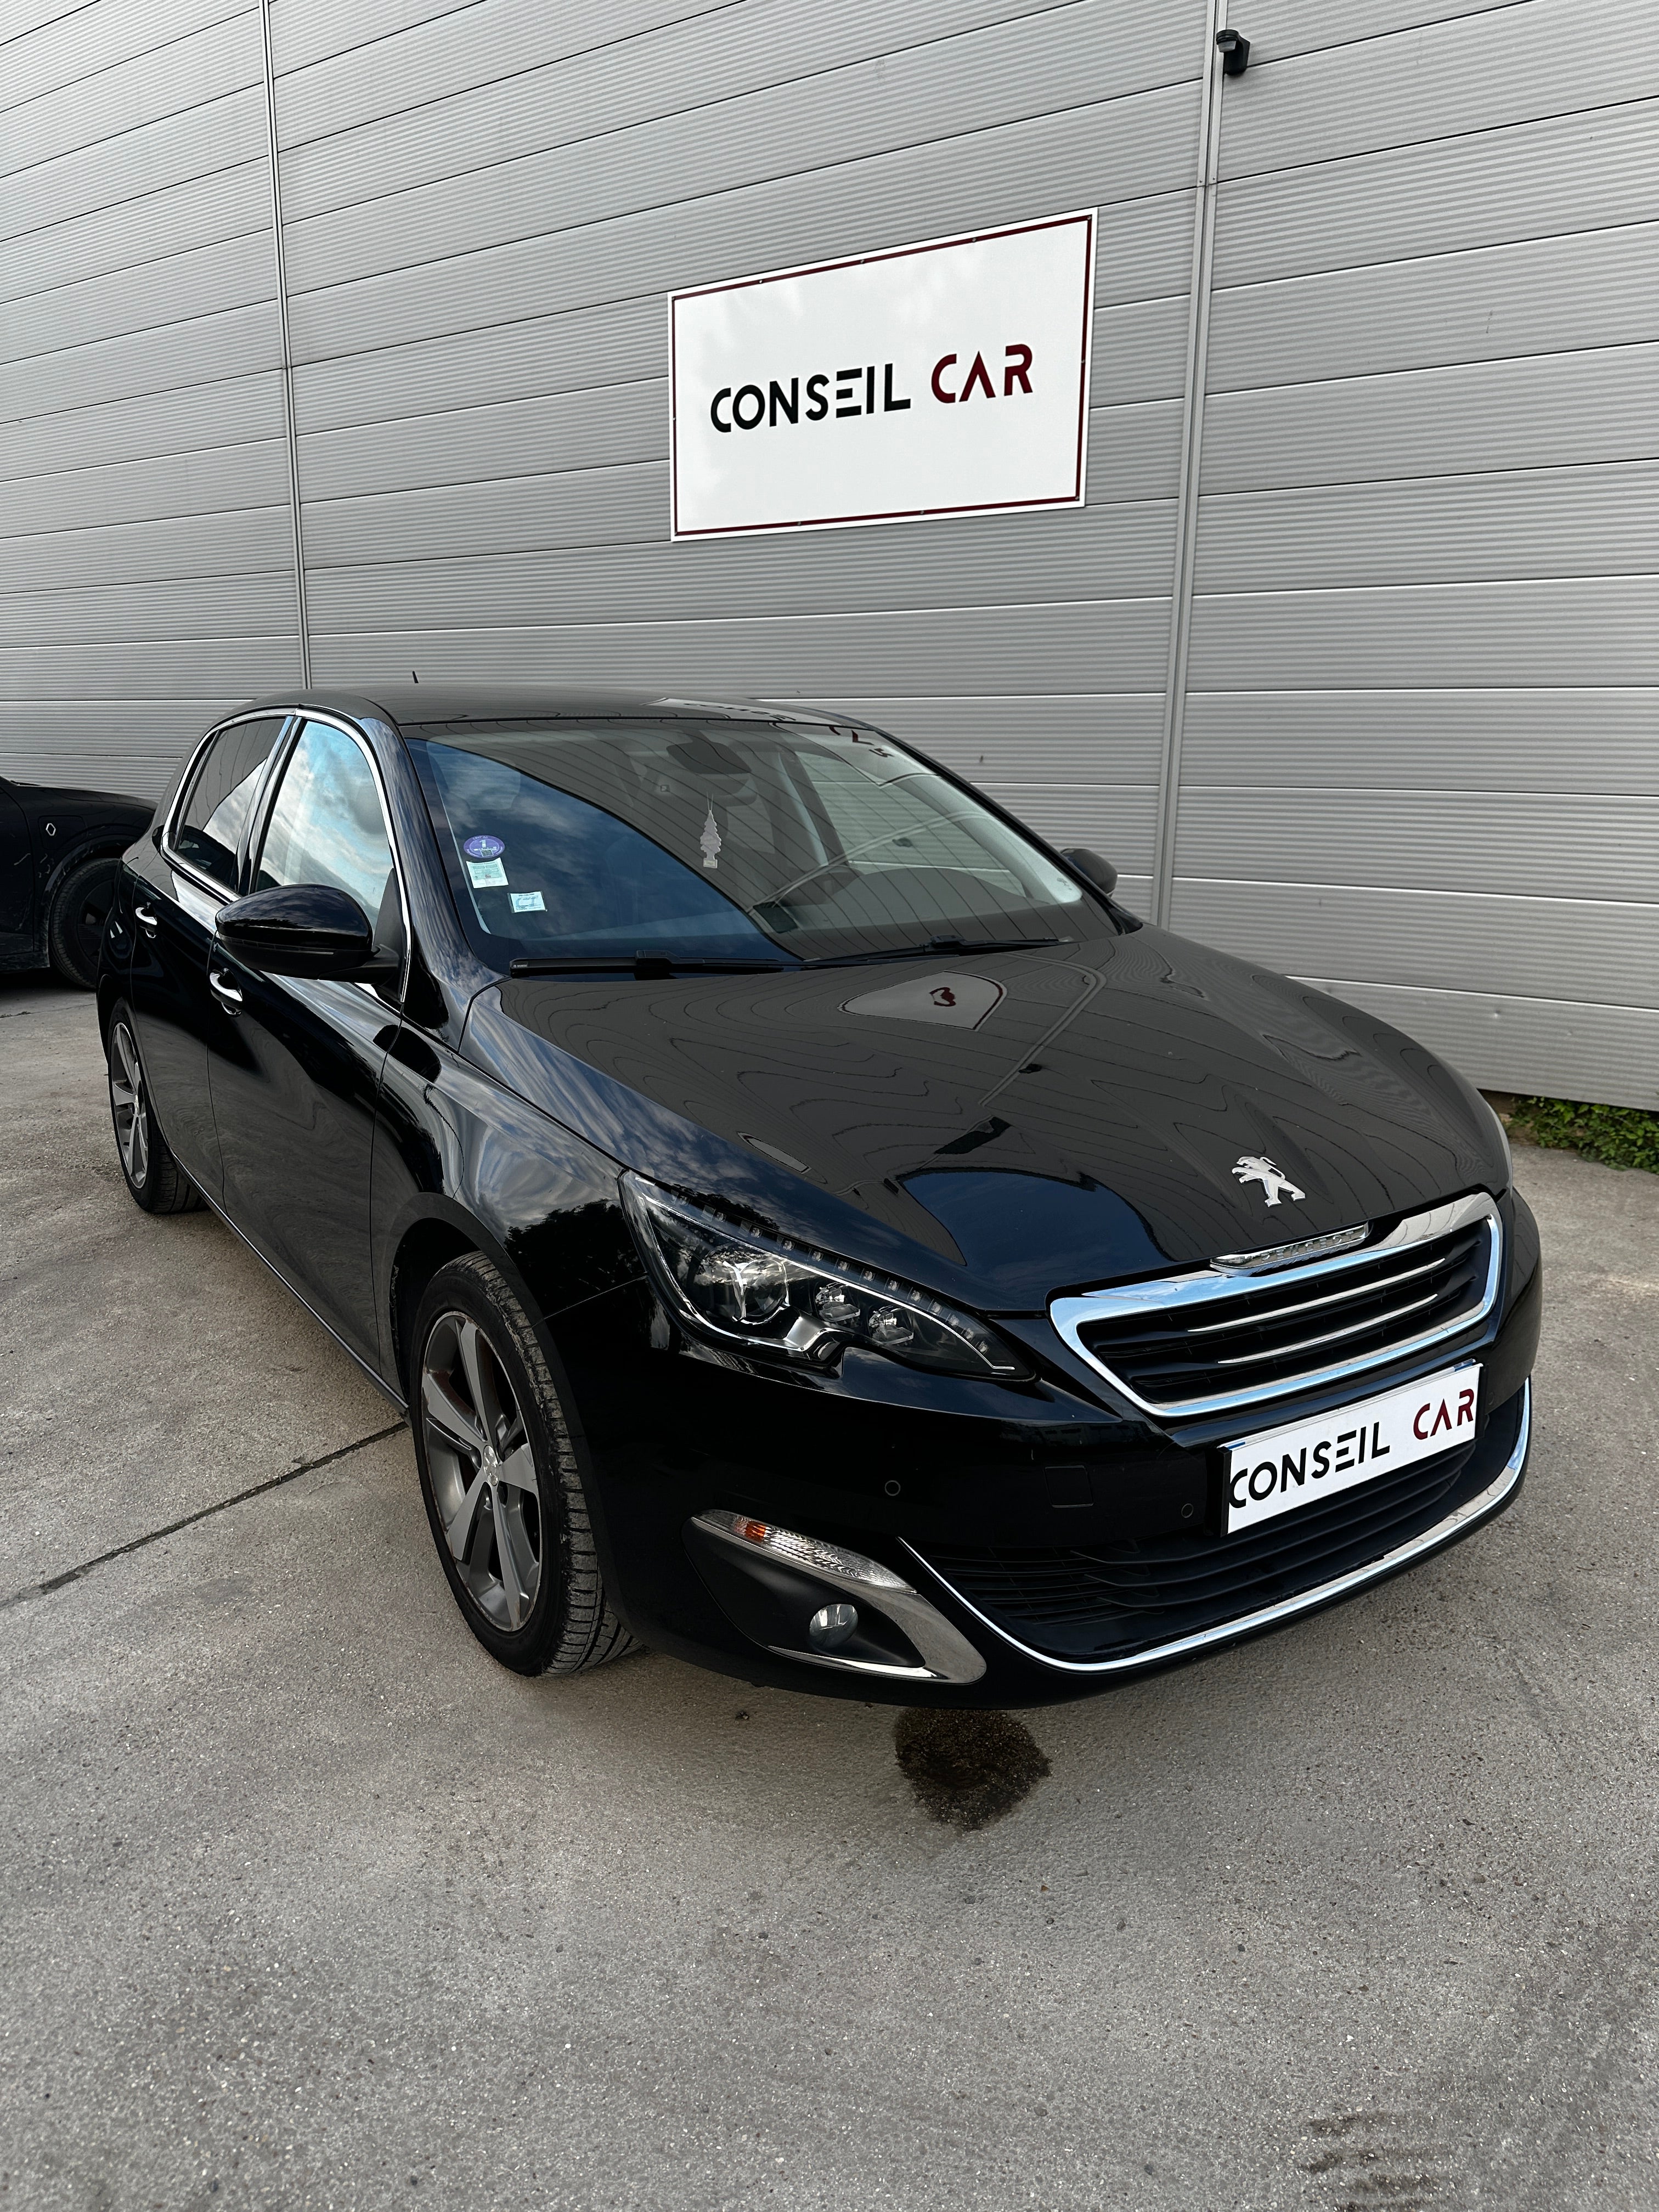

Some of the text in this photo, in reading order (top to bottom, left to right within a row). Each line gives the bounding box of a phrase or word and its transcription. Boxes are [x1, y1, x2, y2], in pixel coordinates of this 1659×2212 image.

[710, 343, 1033, 433] CONSEIL CAR
[1261, 1231, 1354, 1262] PEUGEOT
[1229, 1389, 1474, 1509] CONSEIL CAR
